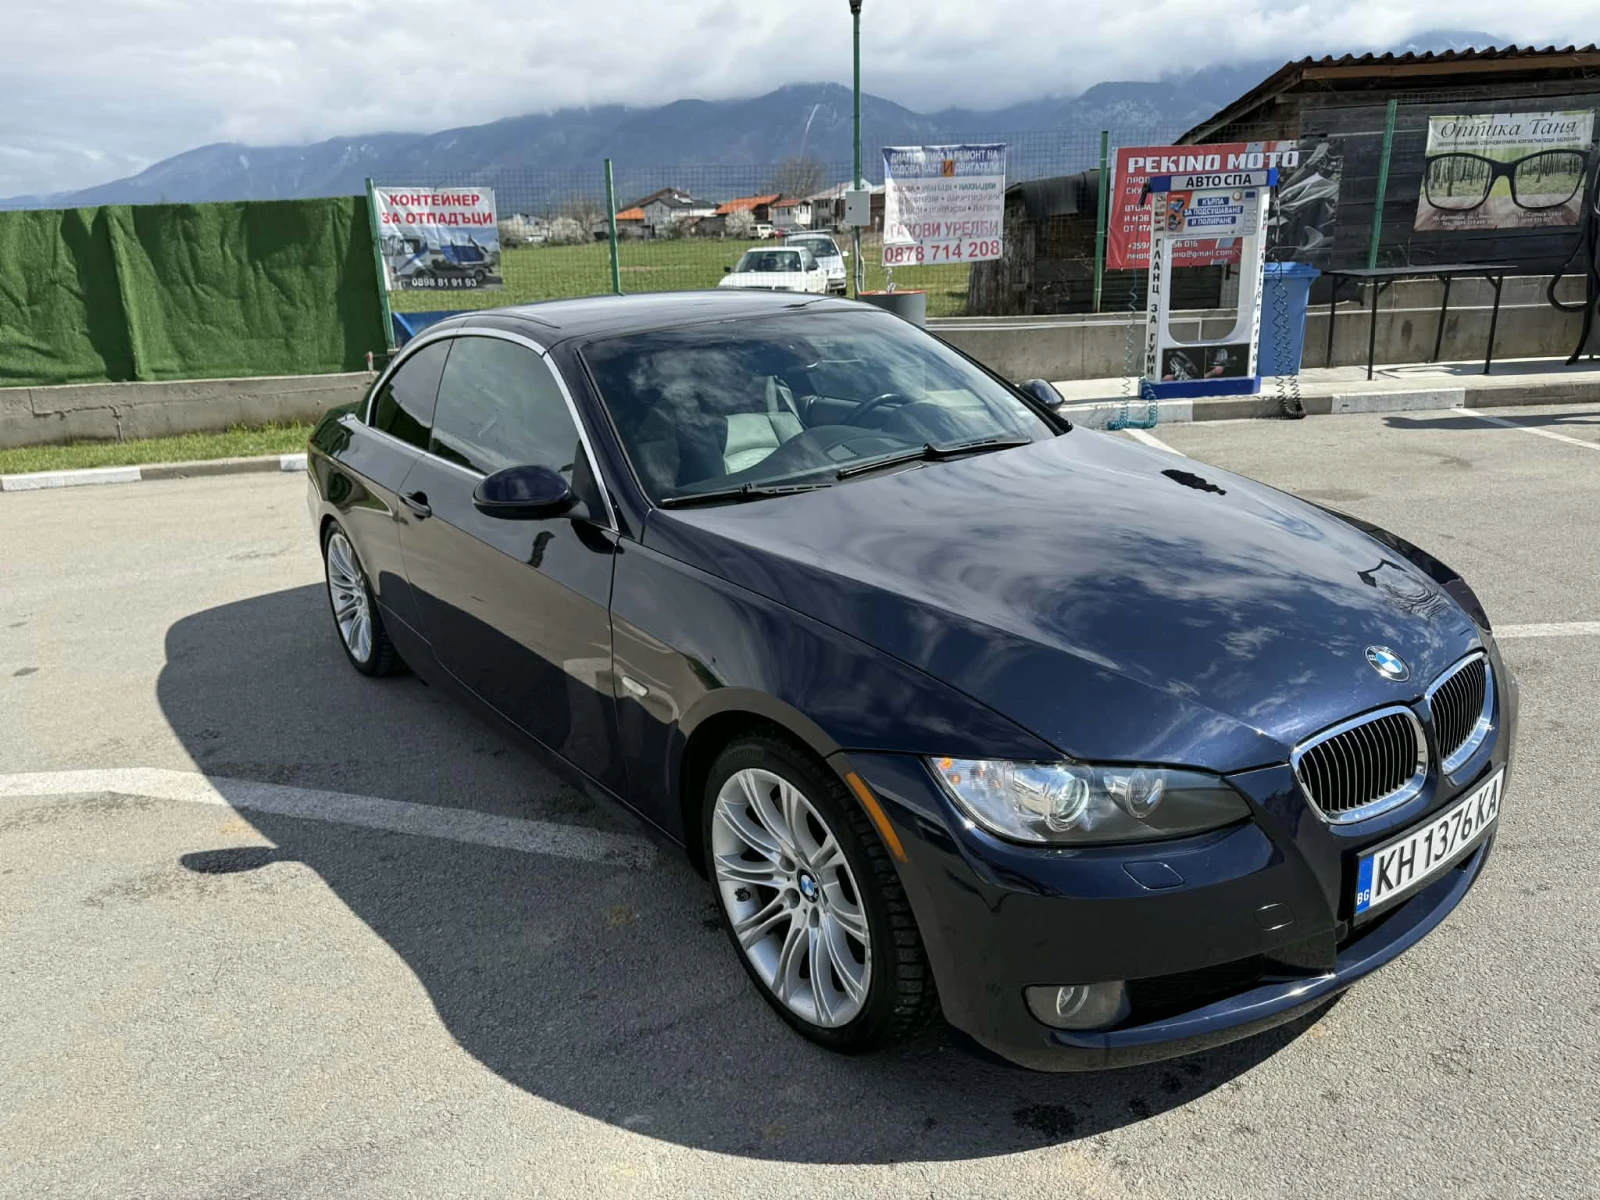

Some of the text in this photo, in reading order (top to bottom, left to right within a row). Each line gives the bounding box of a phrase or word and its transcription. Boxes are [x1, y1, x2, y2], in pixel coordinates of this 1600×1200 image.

[1529, 118, 1577, 135] Таня
[1127, 150, 1299, 174] PEKINO MOTO
[1185, 173, 1252, 188] АВТО СПА
[389, 193, 480, 207] КОНТЕЙНЕР
[382, 212, 493, 226] ЗА ОТПАДЪЦИ
[945, 219, 999, 239] УРЕДБИ
[884, 240, 1000, 263] 0878 714 208
[1147, 238, 1161, 375] ГЛАНЦ ЗА ГУМИ
[1375, 778, 1498, 897] KH 1376 KA
[1356, 889, 1370, 905] BG
